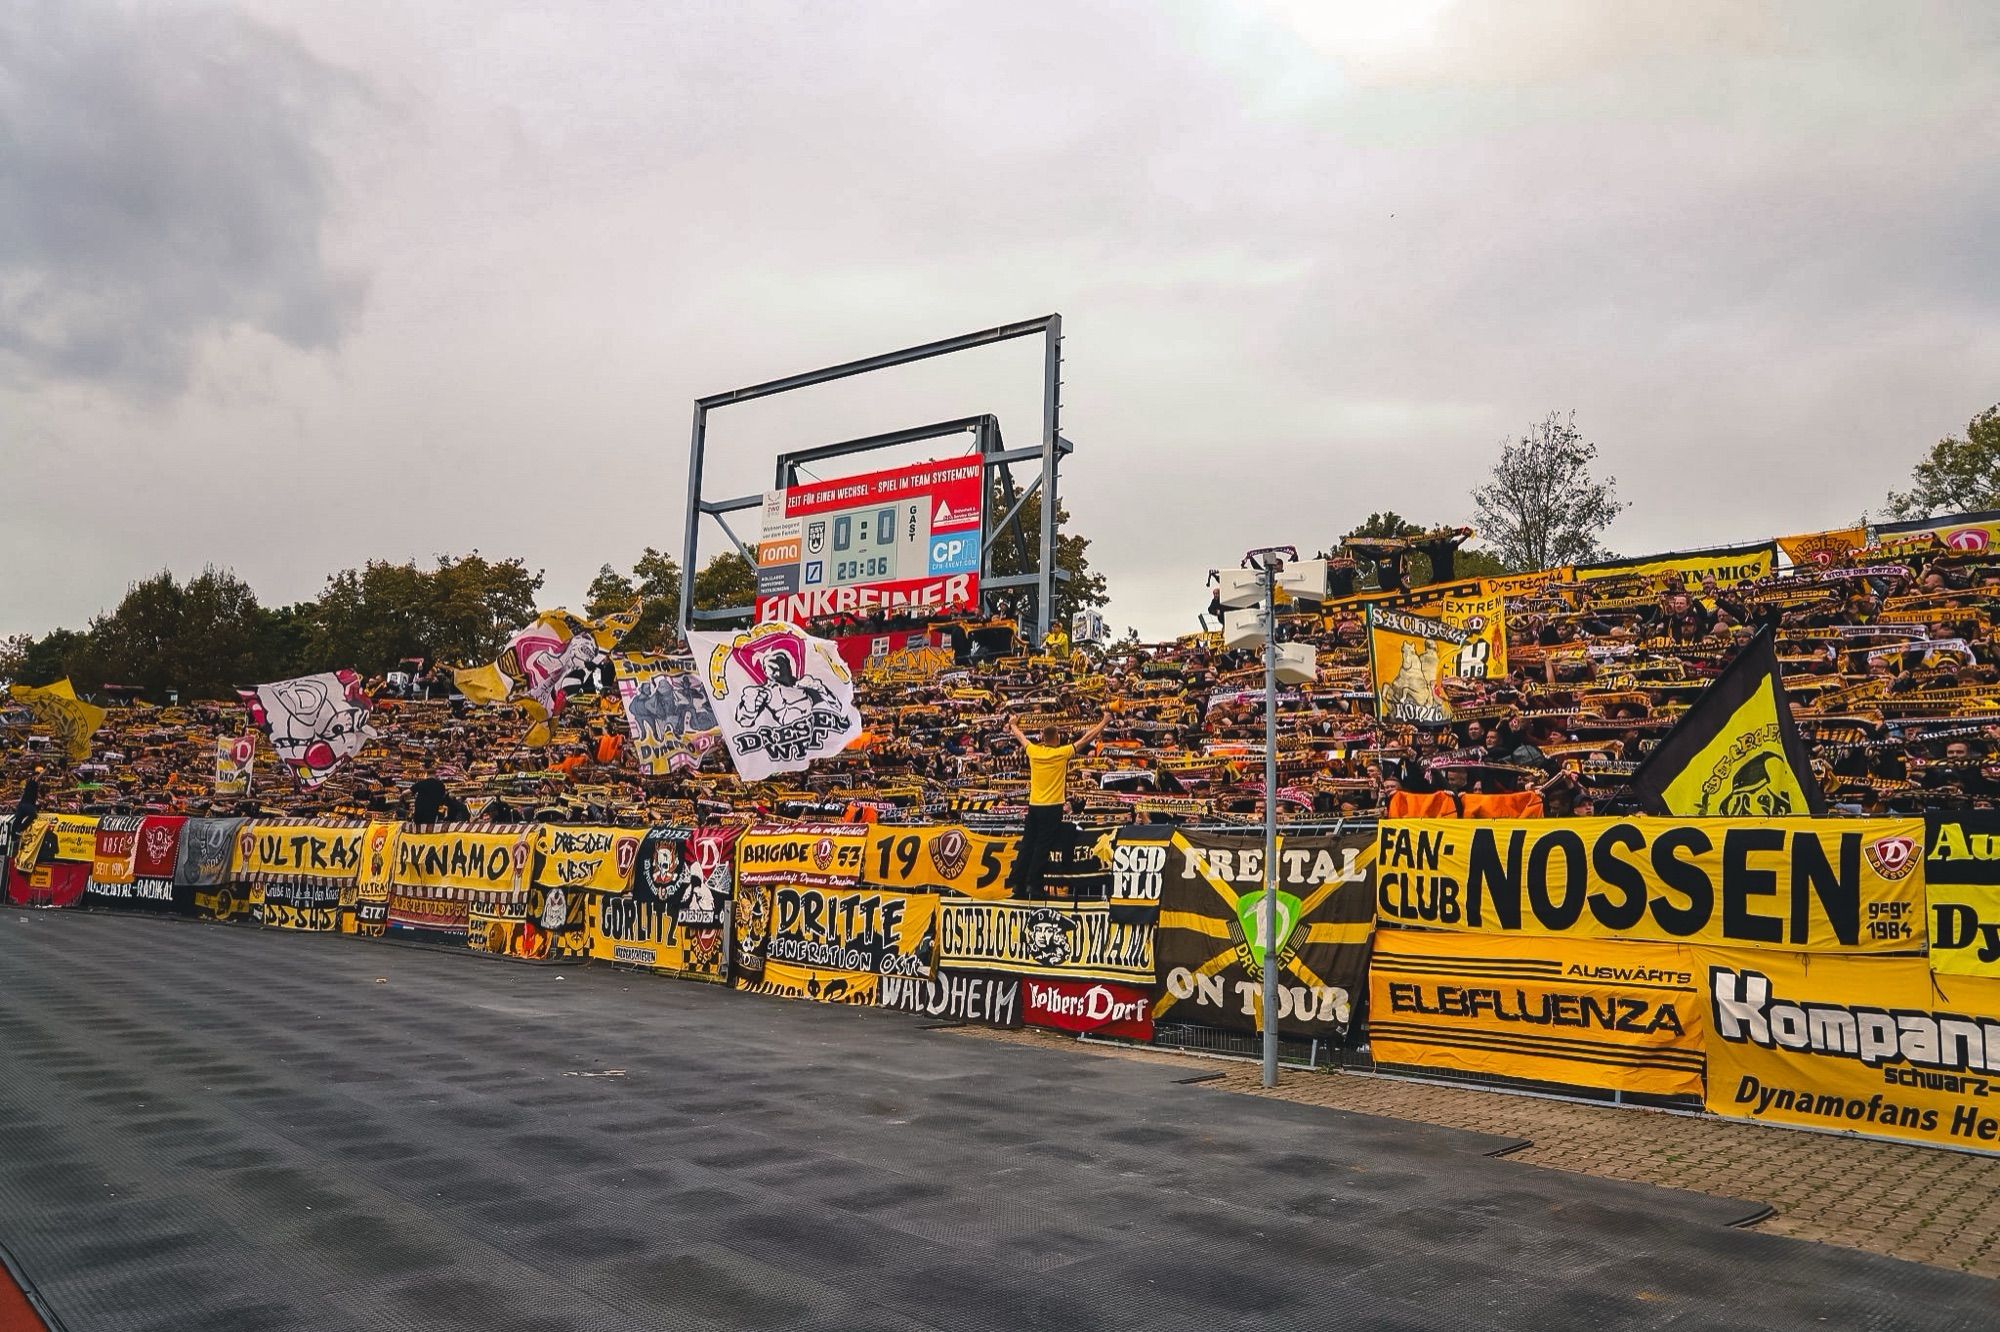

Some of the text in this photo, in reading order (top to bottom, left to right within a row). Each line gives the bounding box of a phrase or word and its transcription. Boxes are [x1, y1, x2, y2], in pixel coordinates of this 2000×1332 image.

[788, 495, 802, 508] ZEIT
[803, 492, 815, 506] FÜR
[816, 489, 836, 503] EINEN
[838, 484, 868, 500] WECHSEL
[878, 477, 898, 492] SPIEL
[899, 475, 908, 489] IM
[911, 472, 930, 488] TEAM
[932, 464, 979, 484] SYSTEMZWO
[909, 505, 917, 542] GAST
[762, 545, 798, 562] roma
[1680, 562, 1761, 585] YNAMICS
[260, 834, 362, 870] ULTRAS
[400, 839, 510, 881] DYNAMO
[552, 832, 613, 855] DRESDEN
[742, 842, 811, 864] BRIGADE
[838, 846, 860, 867] 53
[877, 834, 922, 880] 19
[1112, 845, 1167, 873] SGD
[1379, 826, 1454, 872] FAN-
[558, 860, 602, 884] WEST
[1112, 872, 1163, 900] FLO
[1466, 823, 1863, 946] NOSSEN
[1872, 858, 1916, 880] DRESDEN
[266, 883, 284, 898] Grüße
[1378, 872, 1461, 924] CLUB
[777, 888, 906, 949] DRITTE
[1868, 901, 1913, 920] gegr.
[942, 907, 1031, 961] OSTBLOCK
[1866, 921, 1913, 940] 1984
[1566, 963, 1692, 985] AUSWÄRTS
[882, 970, 1018, 1025] WALDHEIM
[1166, 966, 1350, 1023] ON TOUR
[1390, 982, 1686, 1038] ELBFLUENZA
[1735, 1074, 2000, 1143] Dynamofans He
